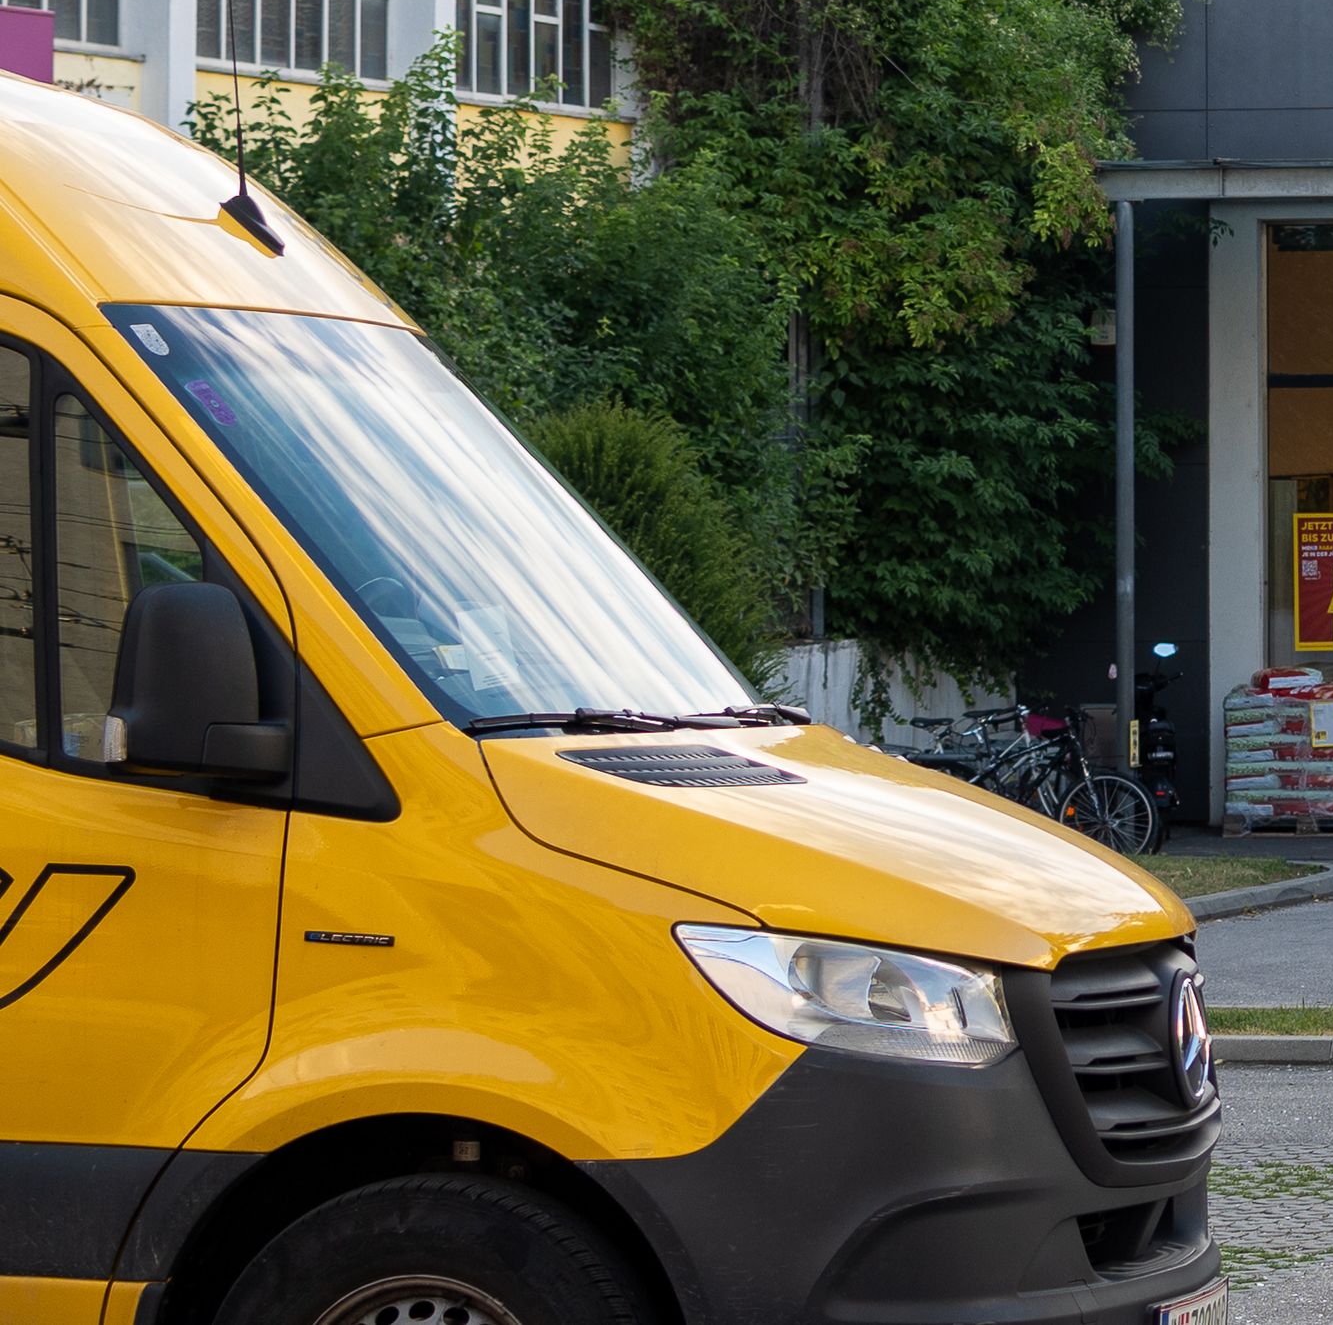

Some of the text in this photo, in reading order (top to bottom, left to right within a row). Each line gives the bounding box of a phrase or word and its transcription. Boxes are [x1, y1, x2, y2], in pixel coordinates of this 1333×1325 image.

[1301, 521, 1333, 530] JETZT
[1301, 534, 1318, 543] BIS
[1320, 533, 1333, 542] ZU
